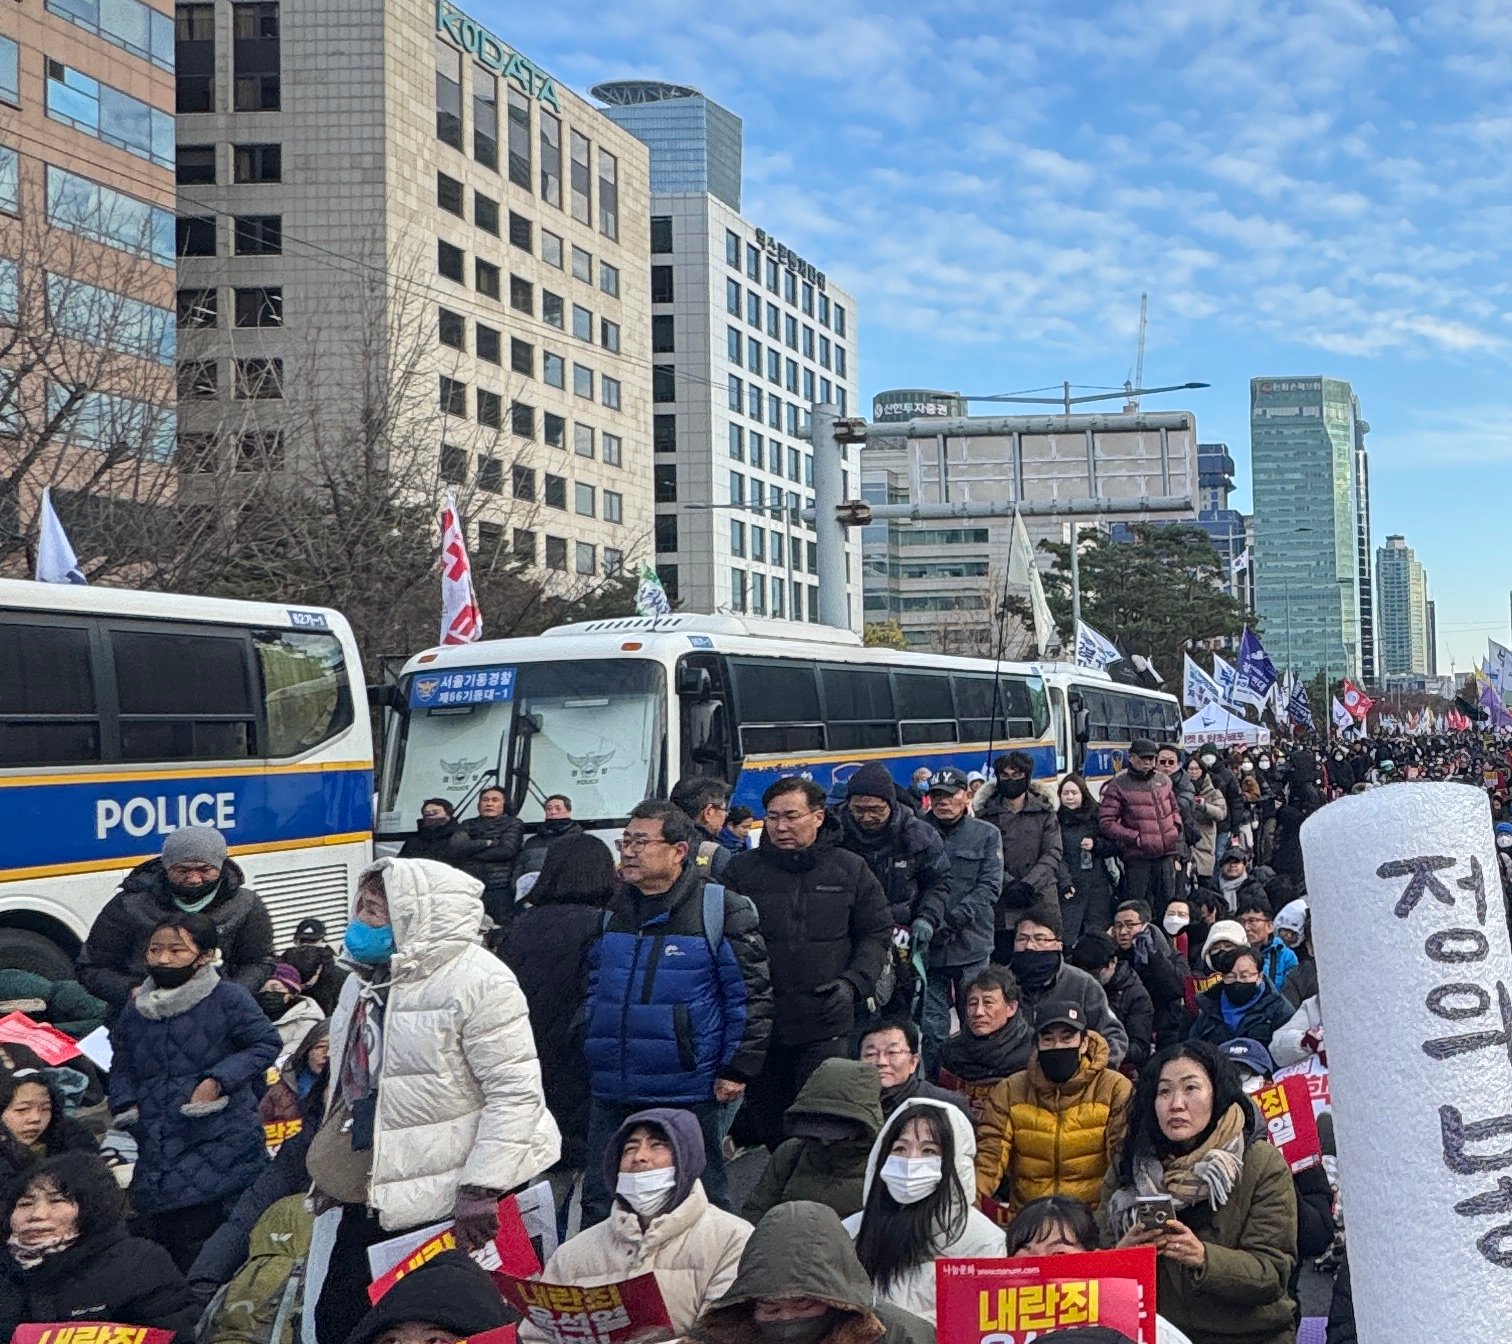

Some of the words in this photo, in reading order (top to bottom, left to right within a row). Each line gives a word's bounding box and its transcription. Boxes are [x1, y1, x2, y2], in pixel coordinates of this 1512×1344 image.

[440, 671, 513, 689] 서울기동경찰
[96, 791, 236, 840] POLICE
[517, 1282, 623, 1313] 내란죄
[979, 1279, 1100, 1332] 내란죄
[528, 1305, 633, 1334] 윤석열
